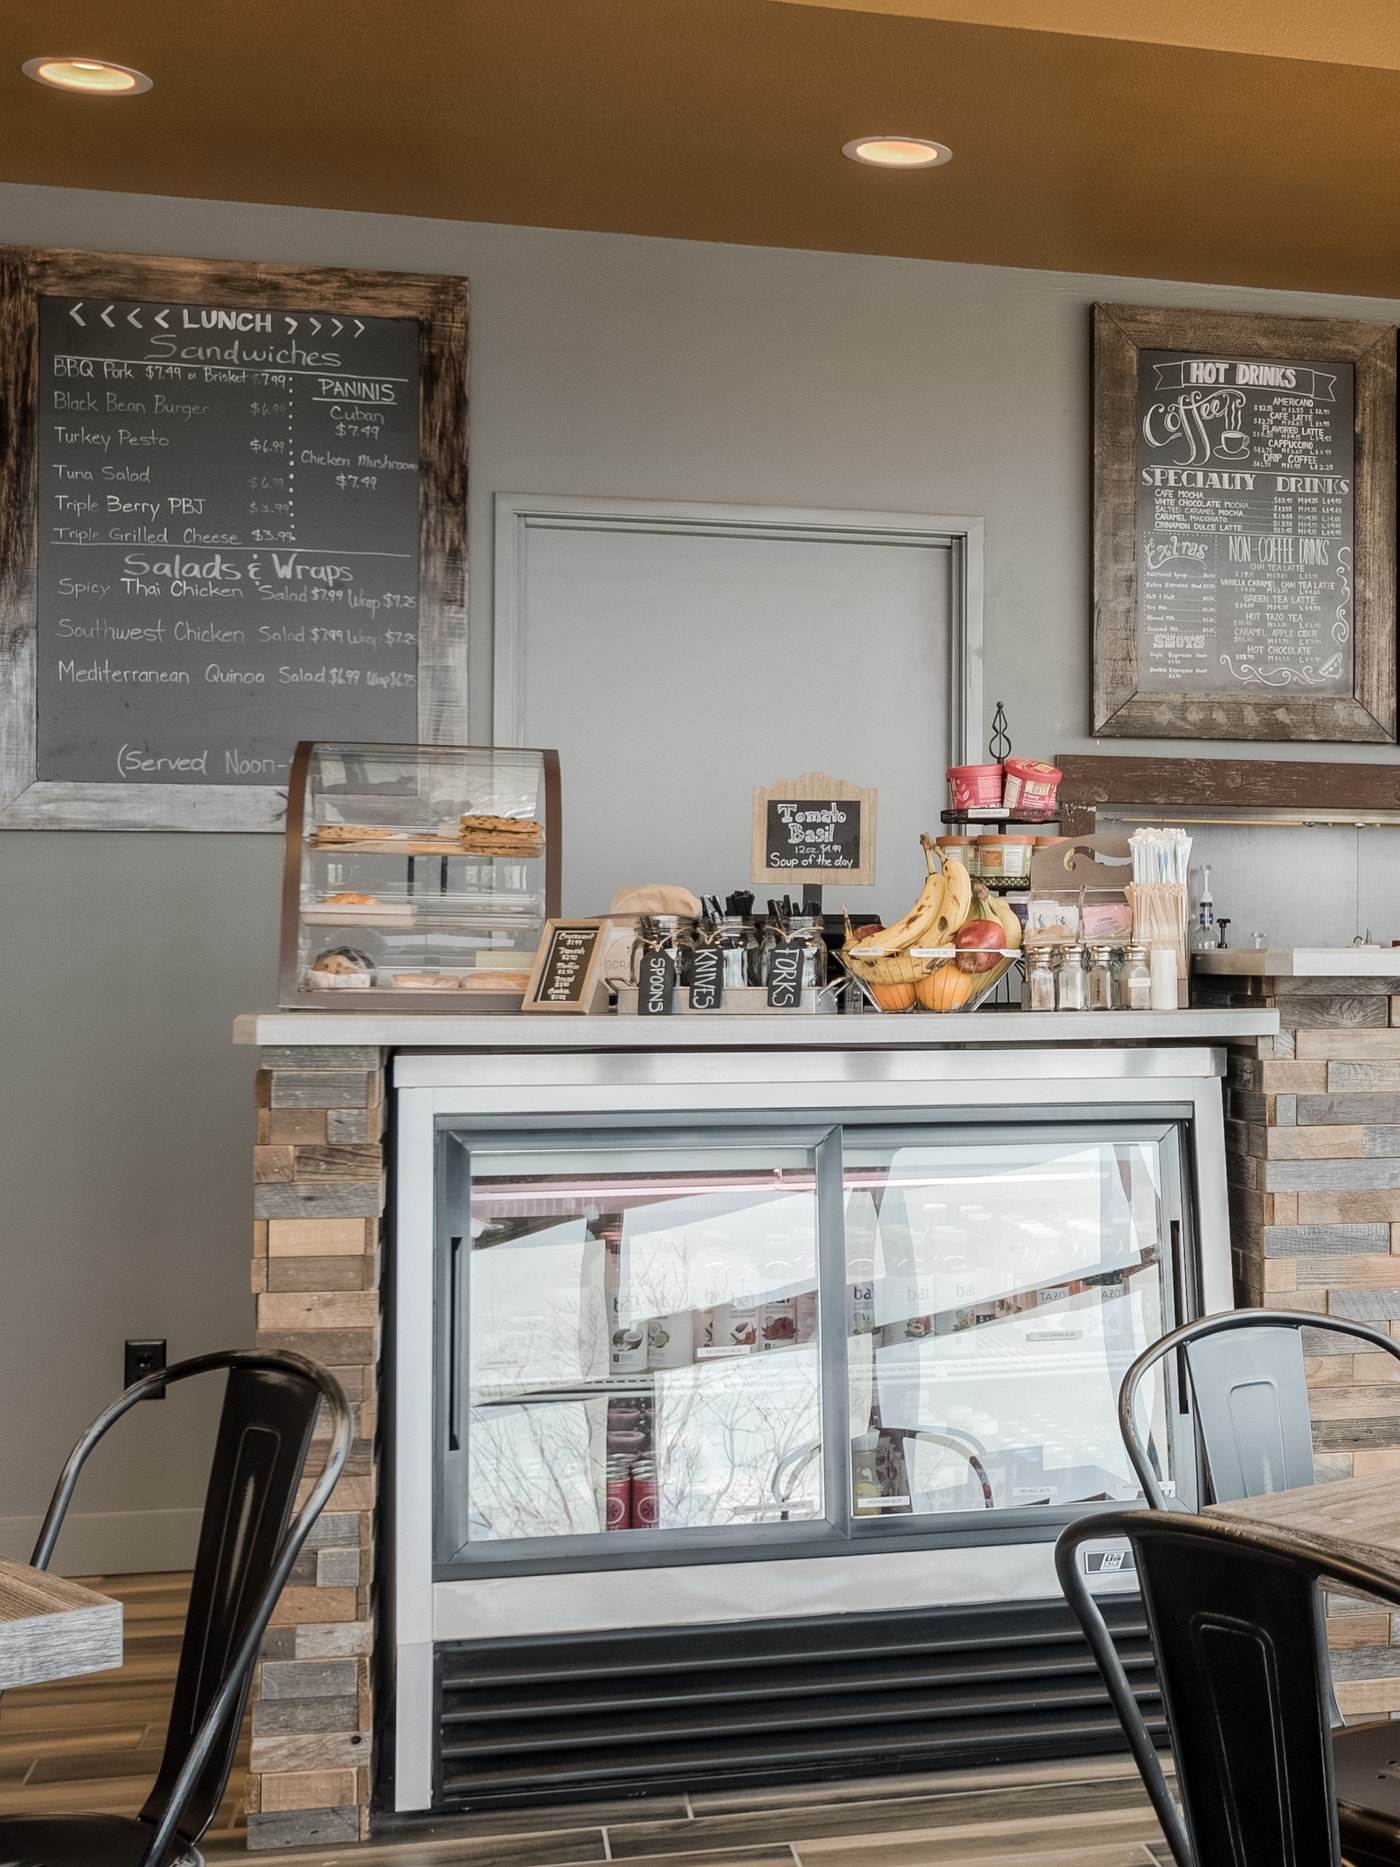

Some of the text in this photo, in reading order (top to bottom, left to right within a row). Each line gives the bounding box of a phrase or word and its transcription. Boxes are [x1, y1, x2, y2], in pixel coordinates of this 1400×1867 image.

[182, 308, 272, 333] LUNCH
[144, 334, 342, 367] Sandwiches
[54, 358, 95, 378] BBQ
[103, 361, 135, 379] Pork
[145, 365, 181, 381] $7.49
[187, 372, 197, 380] or
[203, 367, 246, 383] Brisket
[1189, 362, 1297, 389] HOT DRINKS
[317, 378, 395, 402] PANINIS
[54, 391, 98, 412] Black
[106, 391, 146, 413] Bean
[154, 394, 211, 421] Burger
[1272, 397, 1314, 408] AMERICANO
[330, 405, 385, 425] Cuban
[1269, 412, 1313, 422] CAFE LATTE
[335, 422, 380, 440] $7.49
[1143, 389, 1247, 467] Coffee
[1262, 425, 1324, 437] FLAVORED LATTE
[54, 426, 285, 455] Turkey Pesto $6.99
[1268, 439, 1314, 450] CAPPUCCINO
[301, 450, 350, 467] Chicken
[1263, 453, 1318, 465] DRIP COFFEE
[52, 464, 94, 480] Tuna
[101, 465, 151, 483] Salad
[335, 473, 377, 491] $7.49
[1142, 468, 1350, 496] SPECIALTY DRINKS
[1154, 489, 1204, 499] CAFE MOCHA
[54, 494, 99, 518] Triple
[107, 495, 160, 522] Berry
[168, 497, 206, 515] PBJ
[1154, 498, 1250, 510] WHITE CHOCOLATE MOCHA
[1155, 506, 1181, 514] SALTED
[1218, 509, 1244, 517] MOCHA
[1154, 513, 1187, 522] CARAMEL
[1154, 521, 1243, 532] CINNAMON DULCE LATTE
[53, 527, 99, 544] Triple
[109, 526, 169, 544] Grilled
[183, 527, 242, 545] Cheese
[1146, 536, 1208, 568] Extras
[1229, 535, 1330, 566] NON-COFFEE DRINKS
[124, 553, 242, 581] Salads
[272, 553, 354, 587] Wraps
[1283, 564, 1305, 572] LATTE
[1220, 579, 1335, 590] VANILLA CARAMEL CHAI TEA LATTE
[58, 578, 111, 600] Spicy
[120, 578, 161, 596] Thai
[170, 580, 245, 599] Chicken
[258, 585, 308, 604] Salad
[347, 588, 381, 619] Wrap
[1243, 594, 1317, 605] GREEN TEA LATTE
[1246, 612, 1304, 623] HOT TAZO TEA
[56, 618, 166, 643] Southwest
[174, 620, 246, 643] Chicken
[258, 626, 306, 644] Salad
[1234, 627, 1318, 638] CARAMEL APPLE CIDER
[1247, 645, 1312, 656] HOT CHOCOLATE
[58, 659, 190, 684] Mediterranean
[205, 663, 266, 684] Quinoa
[278, 666, 326, 684] Salad
[117, 743, 294, 778] (Served Noon-
[777, 802, 847, 824] Tomato
[787, 823, 835, 844] Basil
[770, 852, 854, 869] Soup of the day
[606, 960, 631, 970] SCRA
[648, 957, 666, 1014] SPOONS
[692, 948, 719, 1009] KNIVES
[771, 947, 801, 1007] FORKS
[1039, 1291, 1067, 1302] TAZO
[1100, 1288, 1121, 1299] AZO
